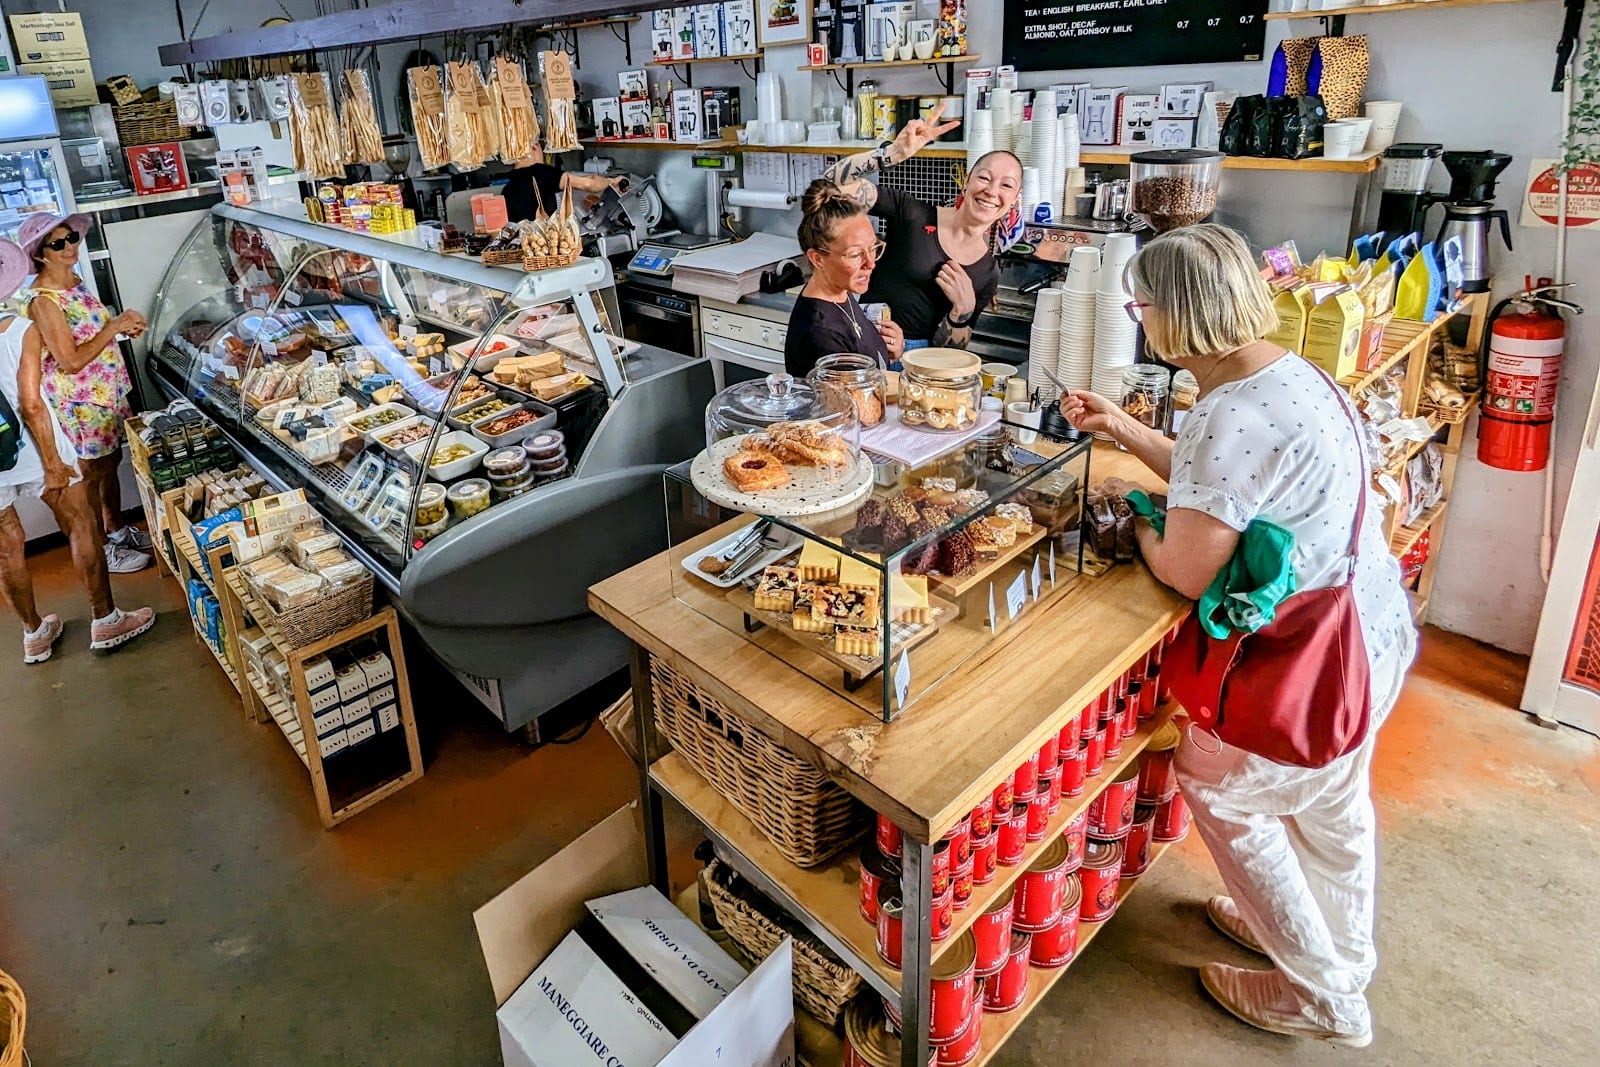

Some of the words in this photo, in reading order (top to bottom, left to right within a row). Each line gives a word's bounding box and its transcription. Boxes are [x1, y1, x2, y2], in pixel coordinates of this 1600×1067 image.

[1042, 5, 1074, 16] ENGLISH
[1075, 1, 1122, 12] BREAKFAST,
[1123, 0, 1145, 8] EARL
[1024, 25, 1047, 33] EXTRA
[1070, 20, 1097, 30] DECAF
[1024, 31, 1059, 40] ALMOND,
[1077, 26, 1111, 36] BONSOY
[1112, 24, 1133, 33] MILK
[1551, 184, 1600, 192] PWDER
[641, 917, 683, 953] APRIRE
[681, 953, 699, 970] DA
[697, 969, 729, 998] LATO
[537, 975, 610, 1060] MANEGGIARE
